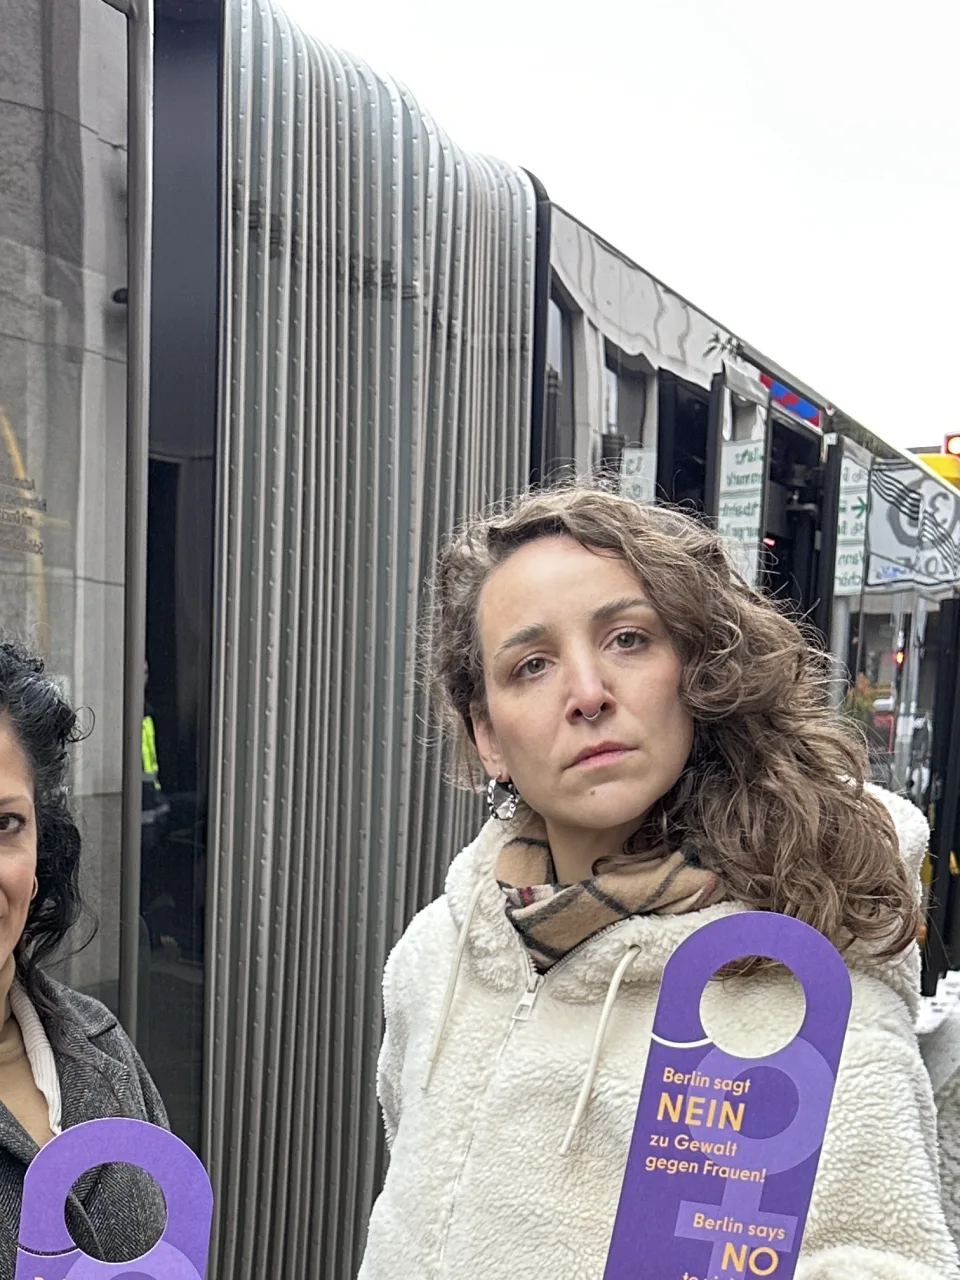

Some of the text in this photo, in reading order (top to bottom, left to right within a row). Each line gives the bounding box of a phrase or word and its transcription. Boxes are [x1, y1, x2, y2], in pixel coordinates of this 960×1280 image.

[663, 1067, 750, 1096] Berlin sagt
[656, 1092, 745, 1131] NEIN
[649, 1134, 737, 1156] zu Gewalt
[645, 1156, 767, 1183] gegen Frauen!
[693, 1213, 785, 1241] Berlin says
[721, 1242, 779, 1276] NO
